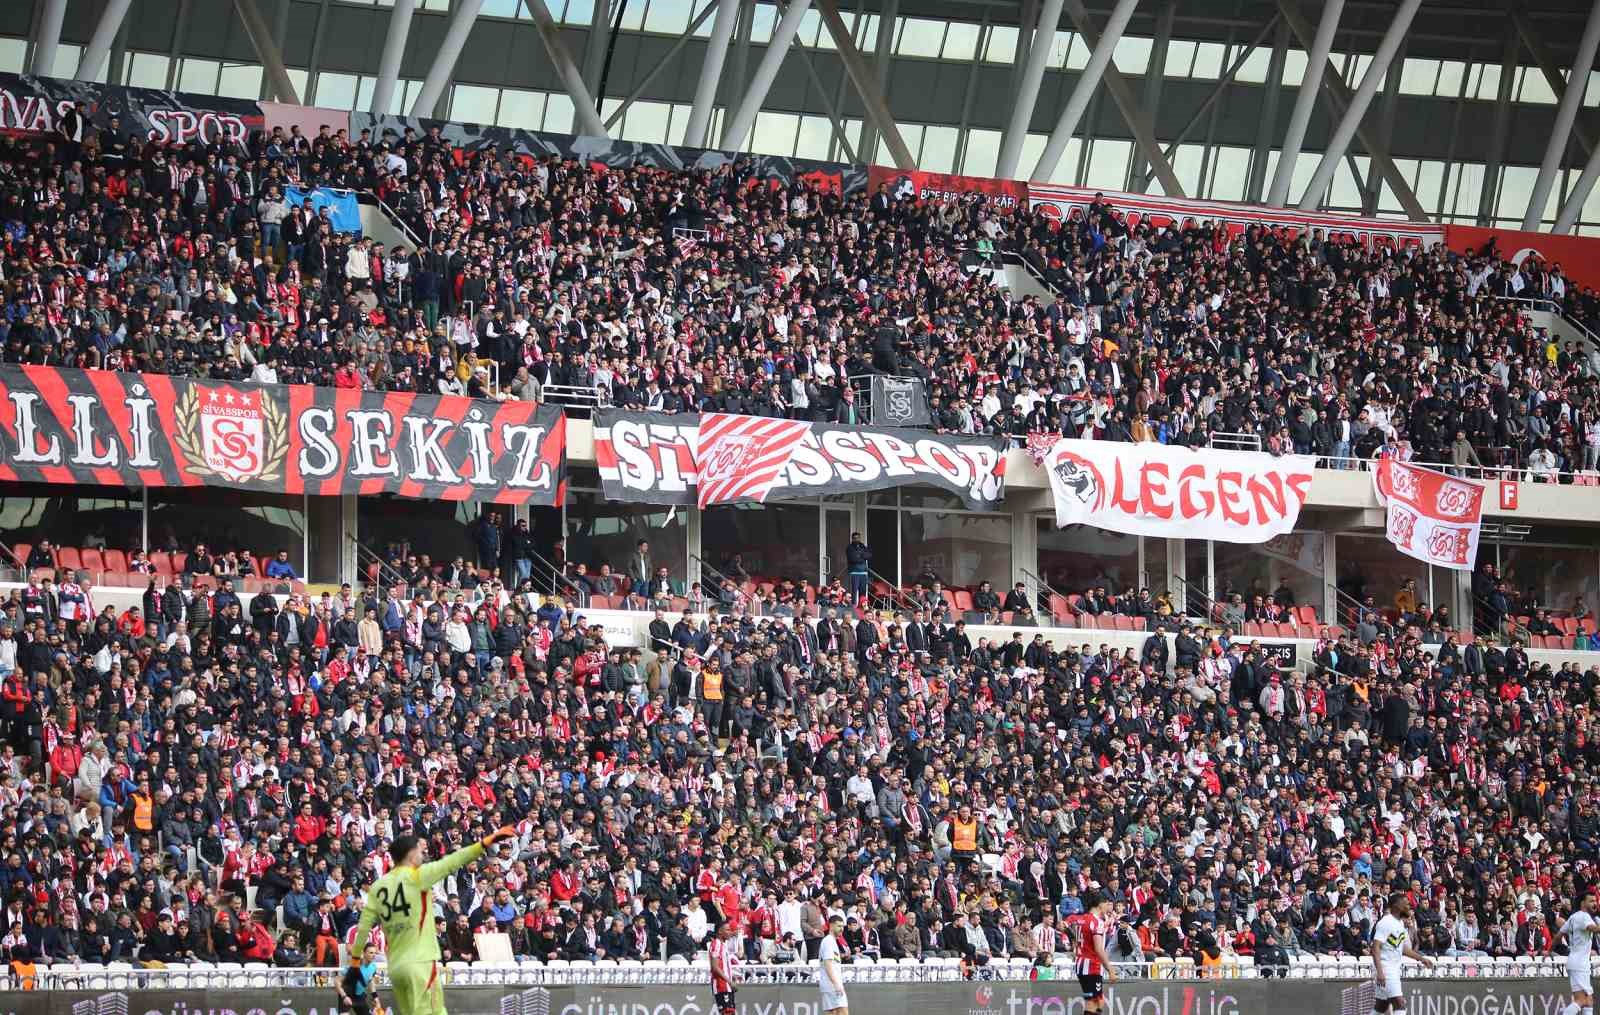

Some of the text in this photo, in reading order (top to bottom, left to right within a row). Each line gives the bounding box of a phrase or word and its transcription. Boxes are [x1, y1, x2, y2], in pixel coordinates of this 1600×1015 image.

[147, 110, 251, 158] SPOR
[202, 403, 258, 419] SİVASSPOR
[300, 407, 550, 489] SEKİZ
[611, 419, 1001, 500] SİSSPOR
[1503, 485, 1516, 505] F
[376, 881, 411, 922] 34
[1404, 988, 1533, 1015] ÜNDOĞAN
